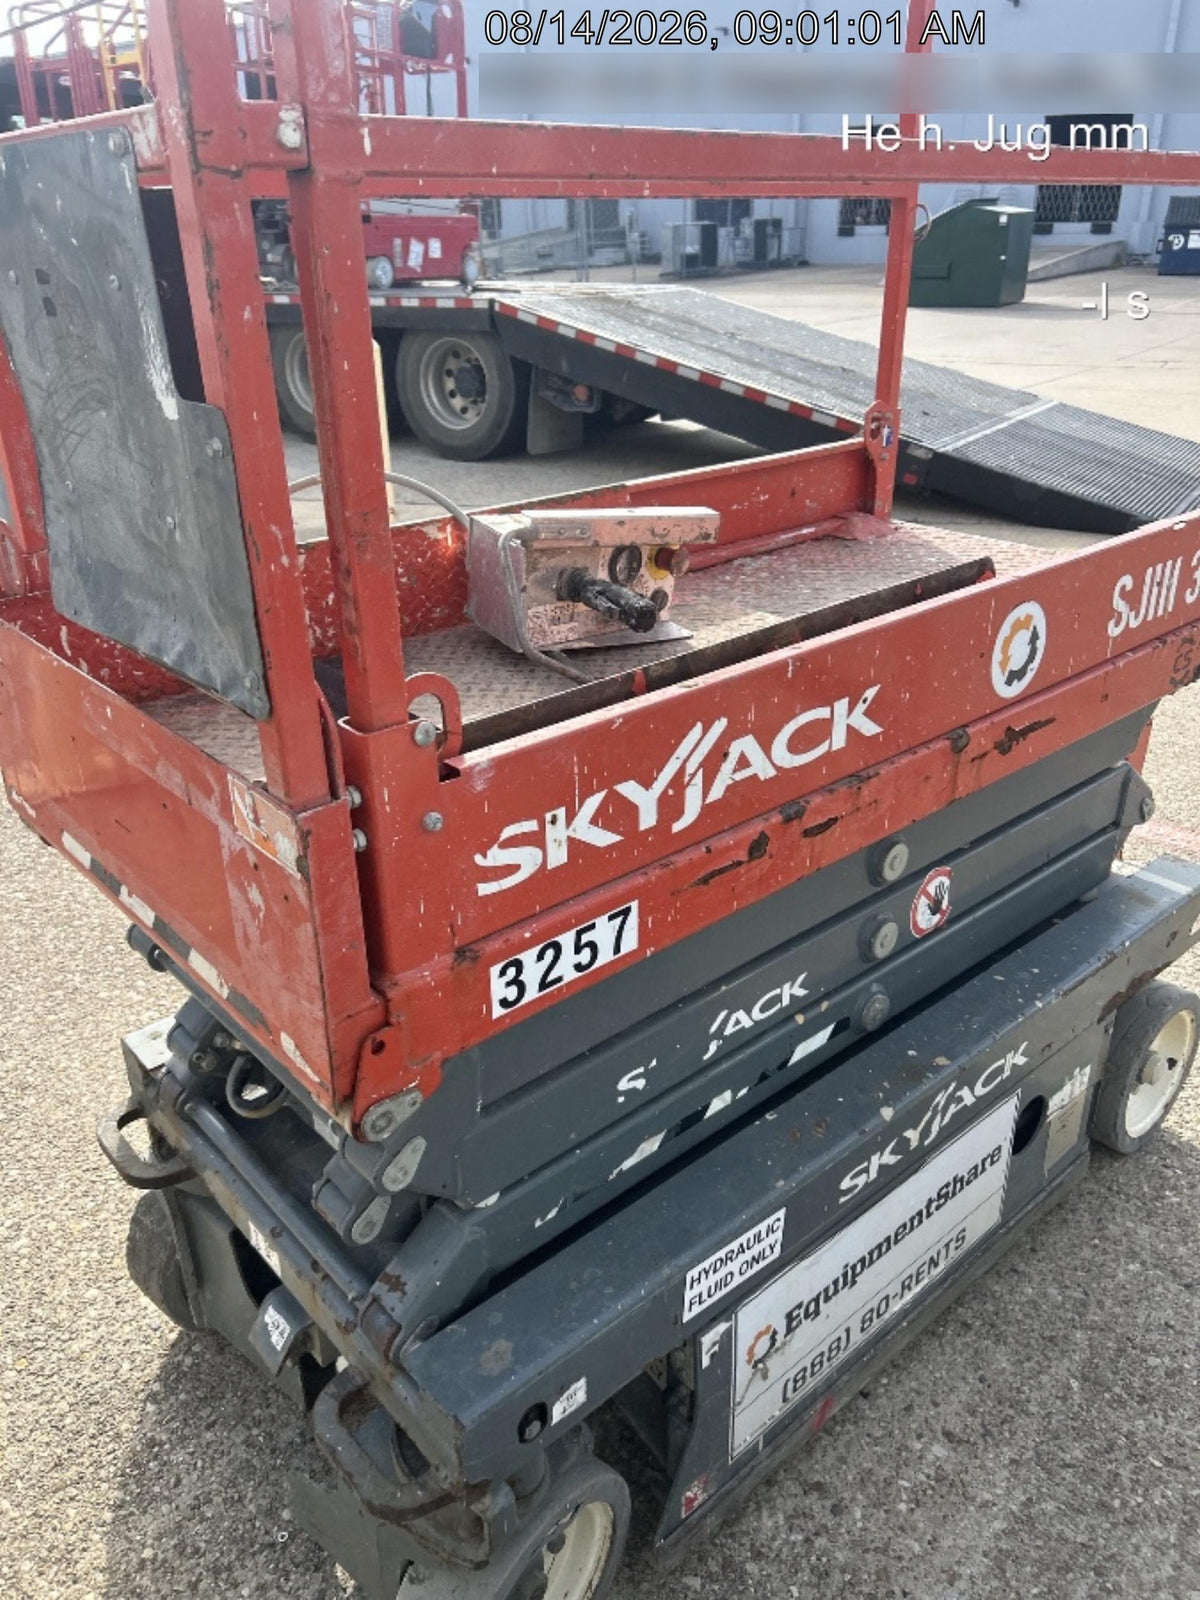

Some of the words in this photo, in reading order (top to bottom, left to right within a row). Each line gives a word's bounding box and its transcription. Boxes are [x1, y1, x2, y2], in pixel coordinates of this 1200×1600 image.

[474, 684, 884, 898] SKYJACK
[496, 906, 635, 1011] 3257
[839, 1041, 1029, 1204] SKYJACK
[688, 1270, 735, 1313] FLUID
[739, 1240, 779, 1276] ONLY
[689, 1217, 781, 1291] HYDRAULIC
[784, 1144, 1005, 1338] EquipmentShare
[782, 1326, 852, 1404] (888)
